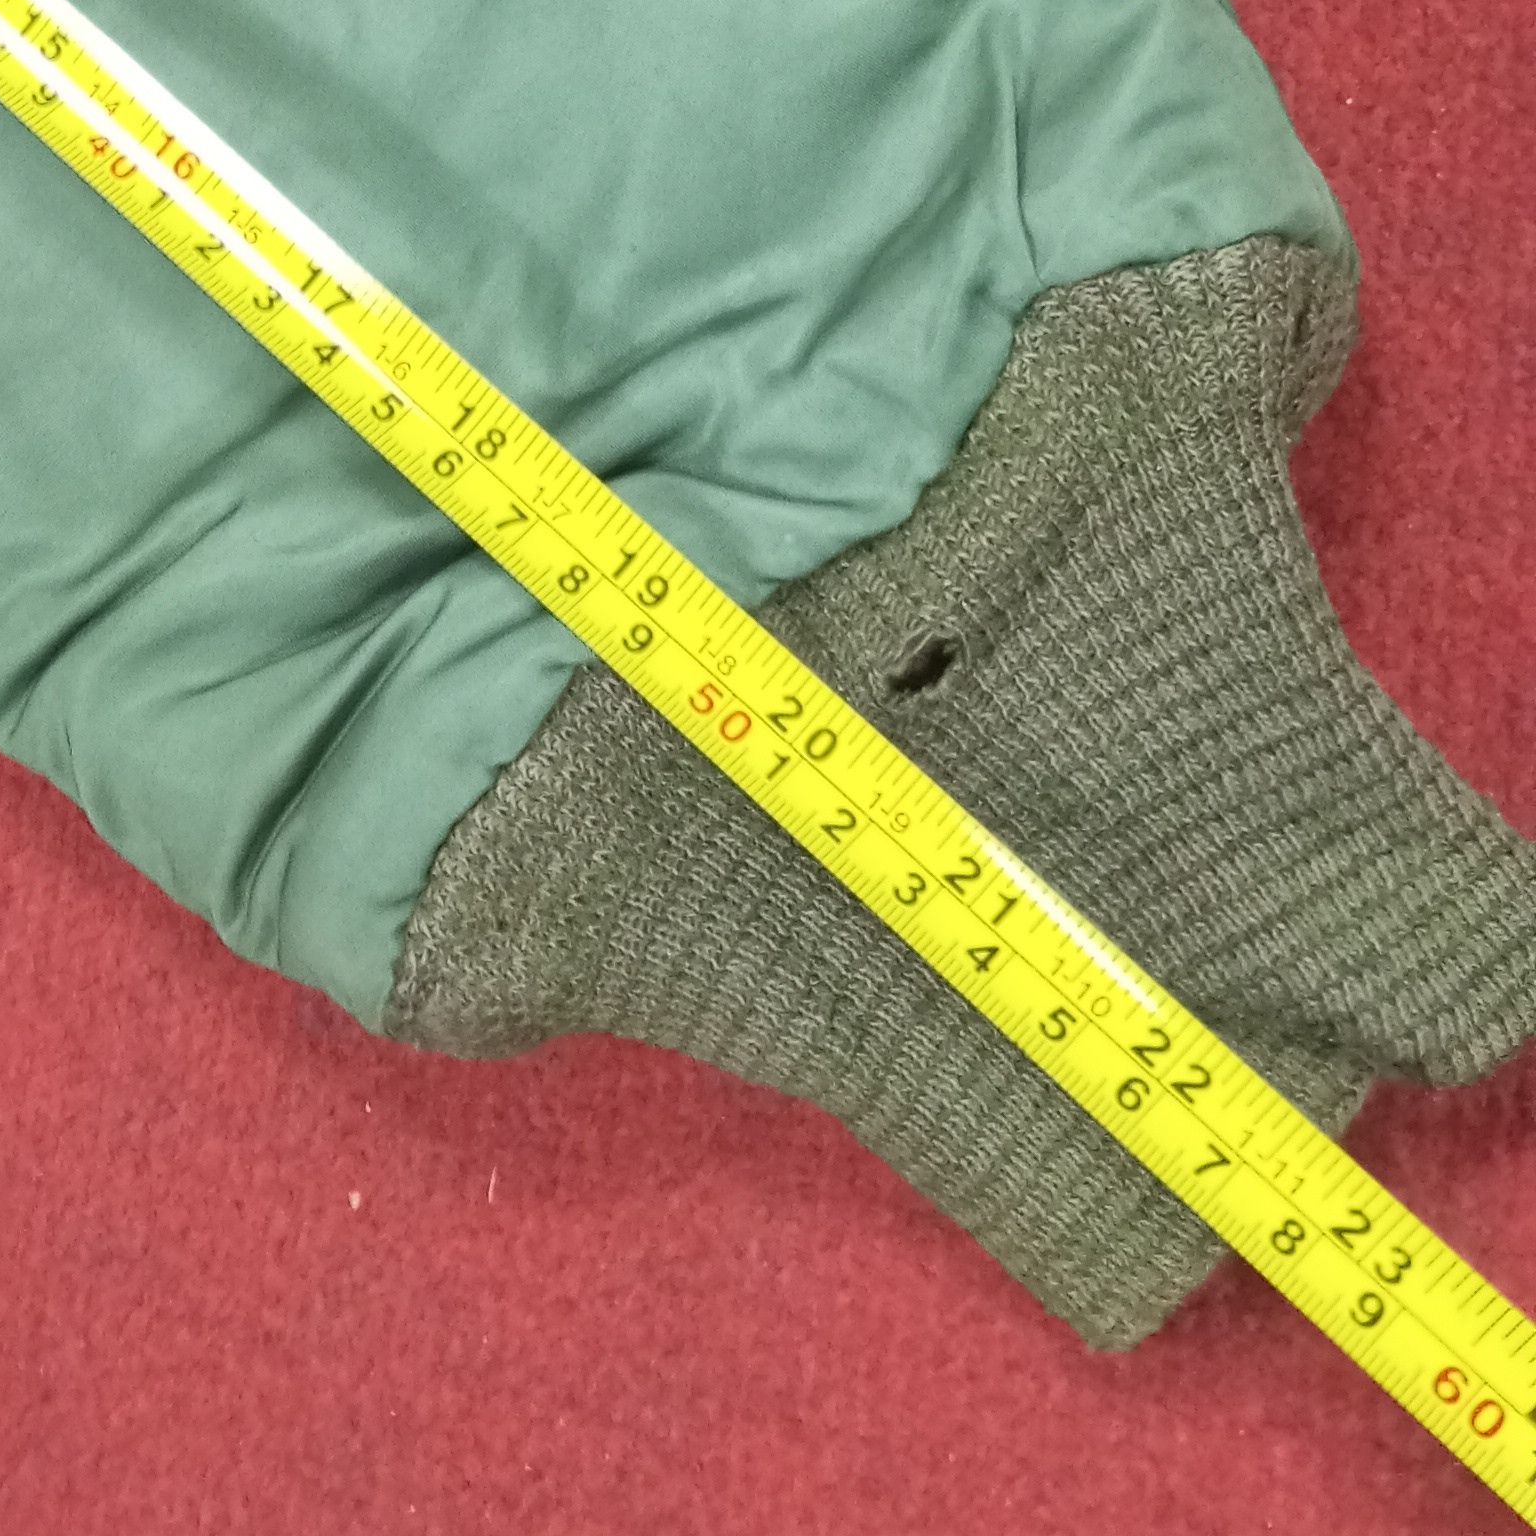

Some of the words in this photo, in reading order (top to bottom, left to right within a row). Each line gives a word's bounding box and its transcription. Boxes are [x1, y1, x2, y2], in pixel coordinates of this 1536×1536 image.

[20, 4, 70, 61] 15
[157, 130, 200, 180] 16
[301, 260, 355, 315] 17
[451, 402, 507, 461] 18
[613, 547, 669, 608] 19
[767, 695, 838, 762] 20
[943, 856, 1018, 926] 21
[1131, 1027, 1211, 1104] 22
[1331, 1208, 1412, 1285] 23
[32, 83, 59, 106] 9
[90, 135, 138, 179] 40
[150, 187, 171, 210] 1
[195, 232, 225, 261] 2
[252, 285, 283, 311] 3
[314, 344, 342, 366] 4
[371, 392, 405, 422] 5
[433, 450, 464, 478] 6
[495, 503, 529, 530] 7
[558, 564, 590, 595] 8
[622, 623, 654, 653] 9
[688, 682, 752, 743] 50
[766, 751, 791, 780] 1
[821, 808, 857, 844] 2
[893, 872, 927, 906] 3
[966, 946, 1000, 973] 4
[1039, 1007, 1077, 1041] 5
[1116, 1077, 1151, 1112] 6
[1193, 1143, 1232, 1176] 7
[1270, 1219, 1306, 1256] 8
[1350, 1291, 1385, 1329] 9
[1433, 1366, 1506, 1439] 60
